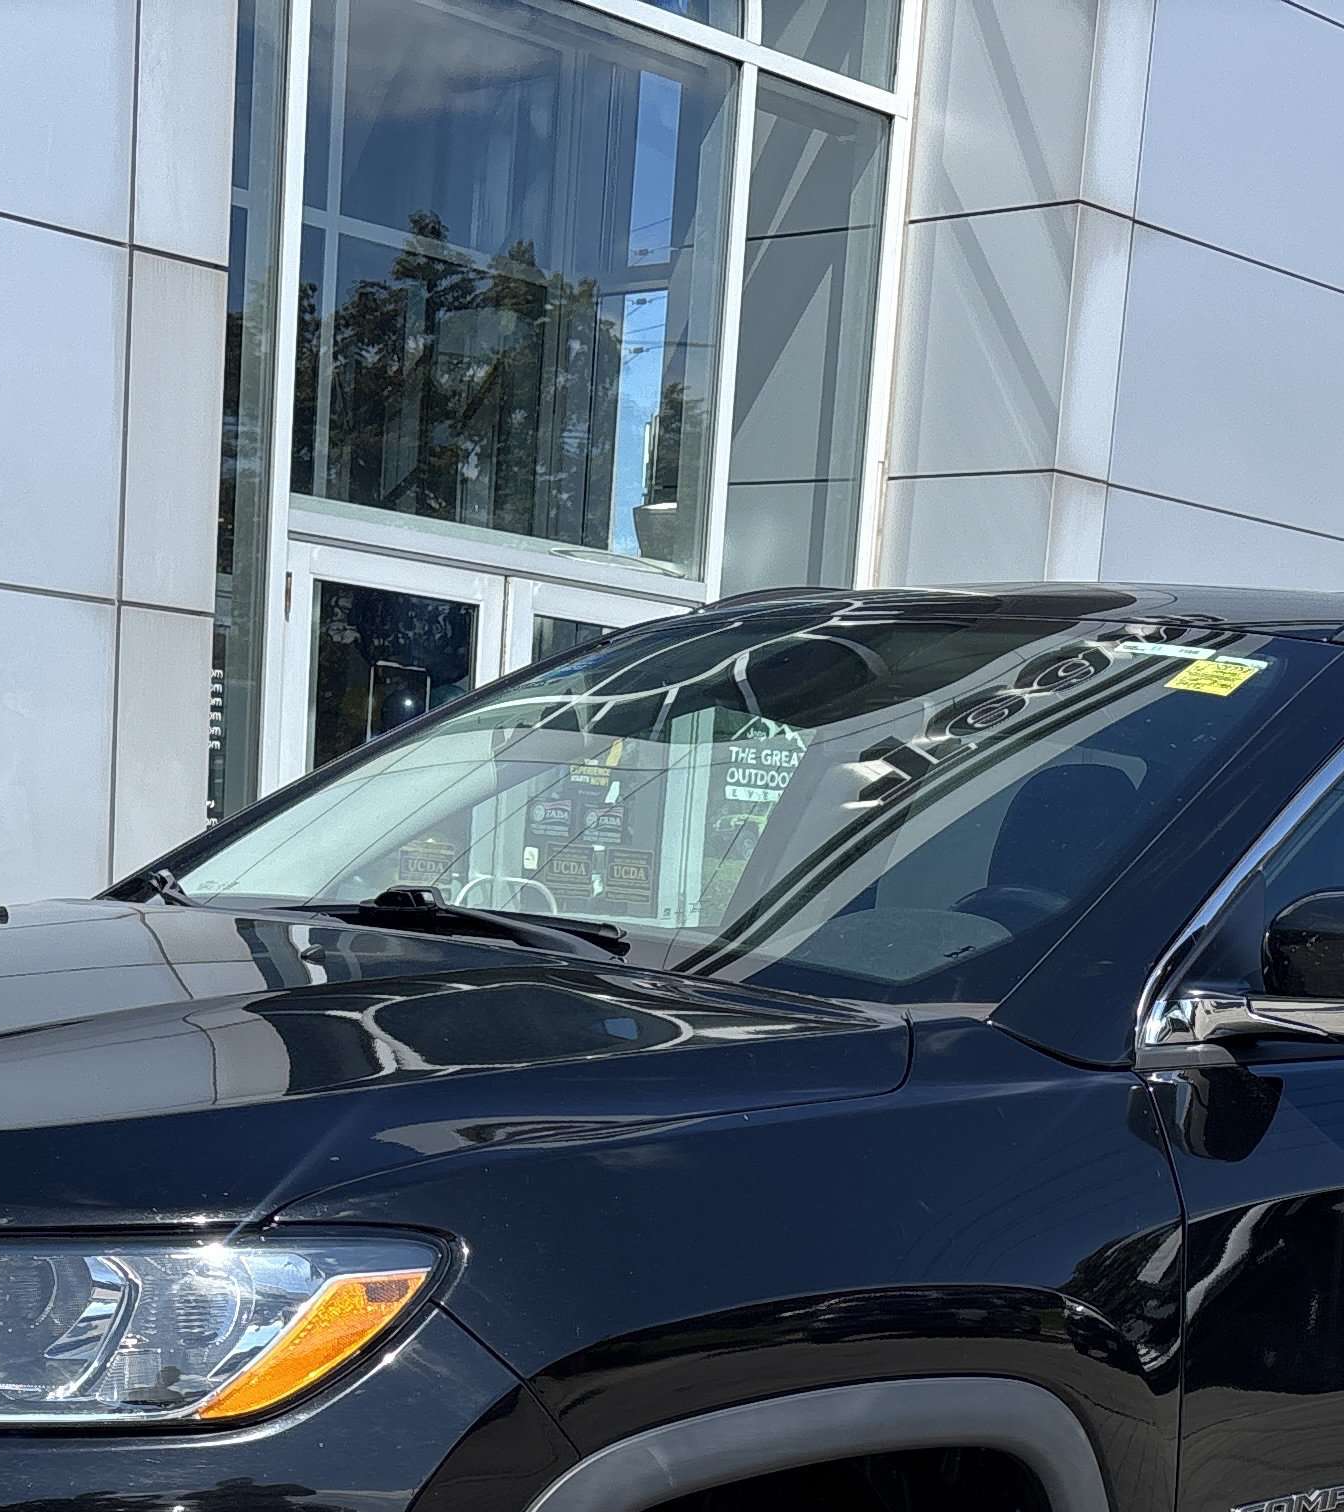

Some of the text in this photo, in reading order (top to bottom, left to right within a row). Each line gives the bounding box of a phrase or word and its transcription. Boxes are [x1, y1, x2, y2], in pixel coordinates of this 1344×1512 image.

[728, 746, 757, 764] THE
[726, 767, 794, 788] OUTDOO
[408, 859, 445, 874] UCDA
[553, 860, 587, 876] UCDA
[613, 865, 646, 881] UCDA
